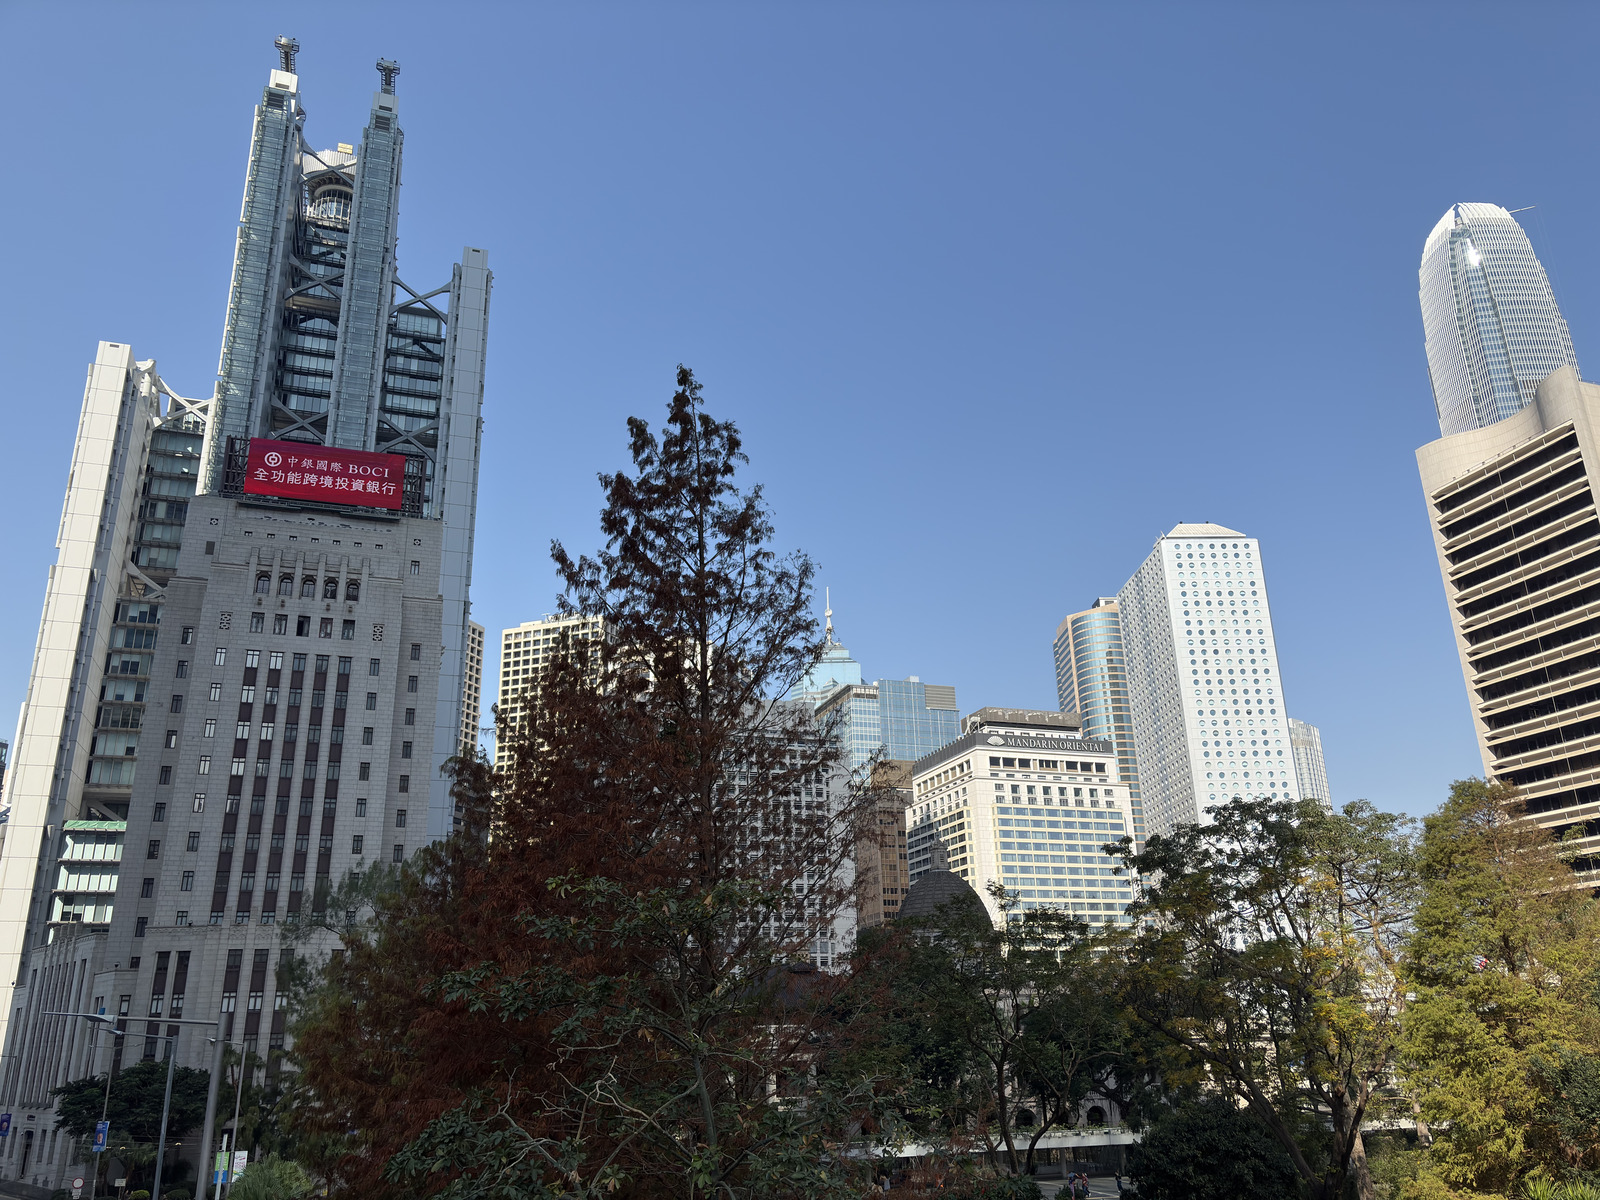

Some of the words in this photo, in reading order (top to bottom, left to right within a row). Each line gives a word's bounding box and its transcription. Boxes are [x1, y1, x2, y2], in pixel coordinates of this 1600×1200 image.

[288, 455, 343, 473] 中銀國際
[348, 463, 389, 478] BOCI
[253, 468, 396, 496] 全功能跨境投資銀行
[1007, 737, 1058, 749] MANDARIN
[1059, 740, 1104, 752] ORIENTAL
